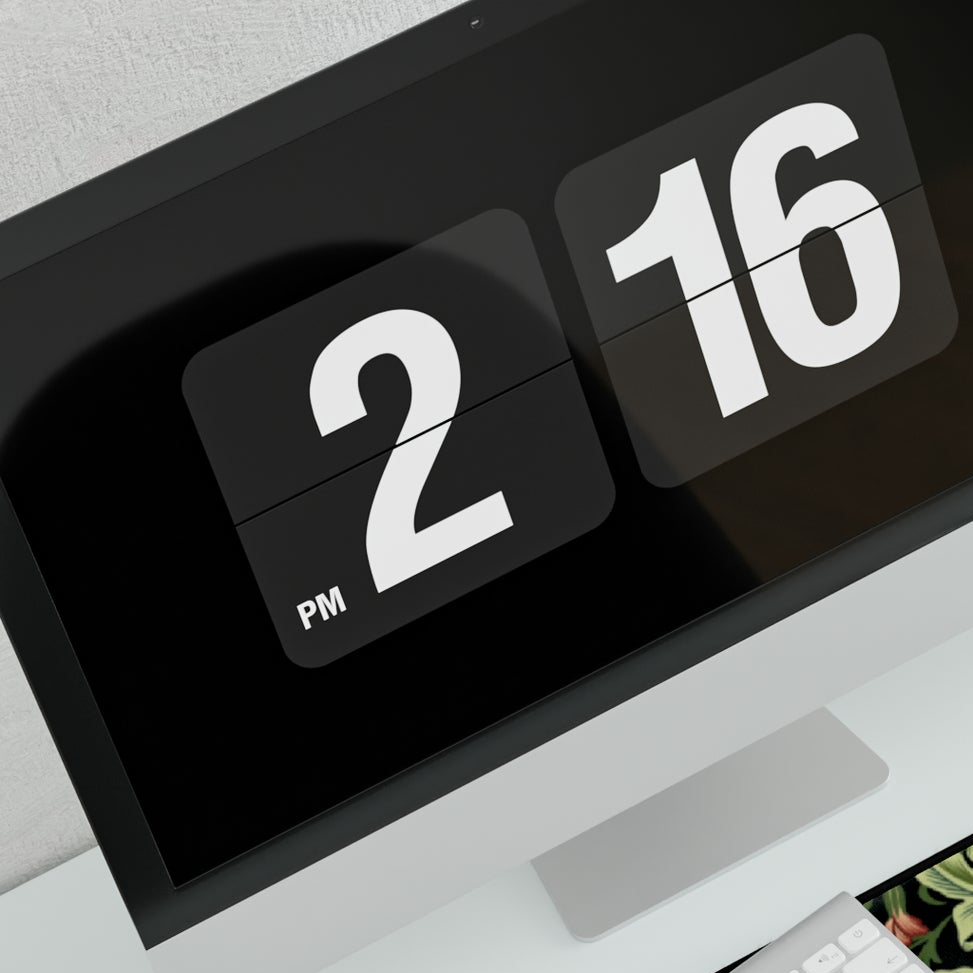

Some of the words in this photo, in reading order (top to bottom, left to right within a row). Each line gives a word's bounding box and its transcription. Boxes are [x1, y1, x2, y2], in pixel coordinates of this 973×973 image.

[309, 308, 514, 594] 2
[605, 102, 901, 418] 16
[296, 585, 347, 631] PM
